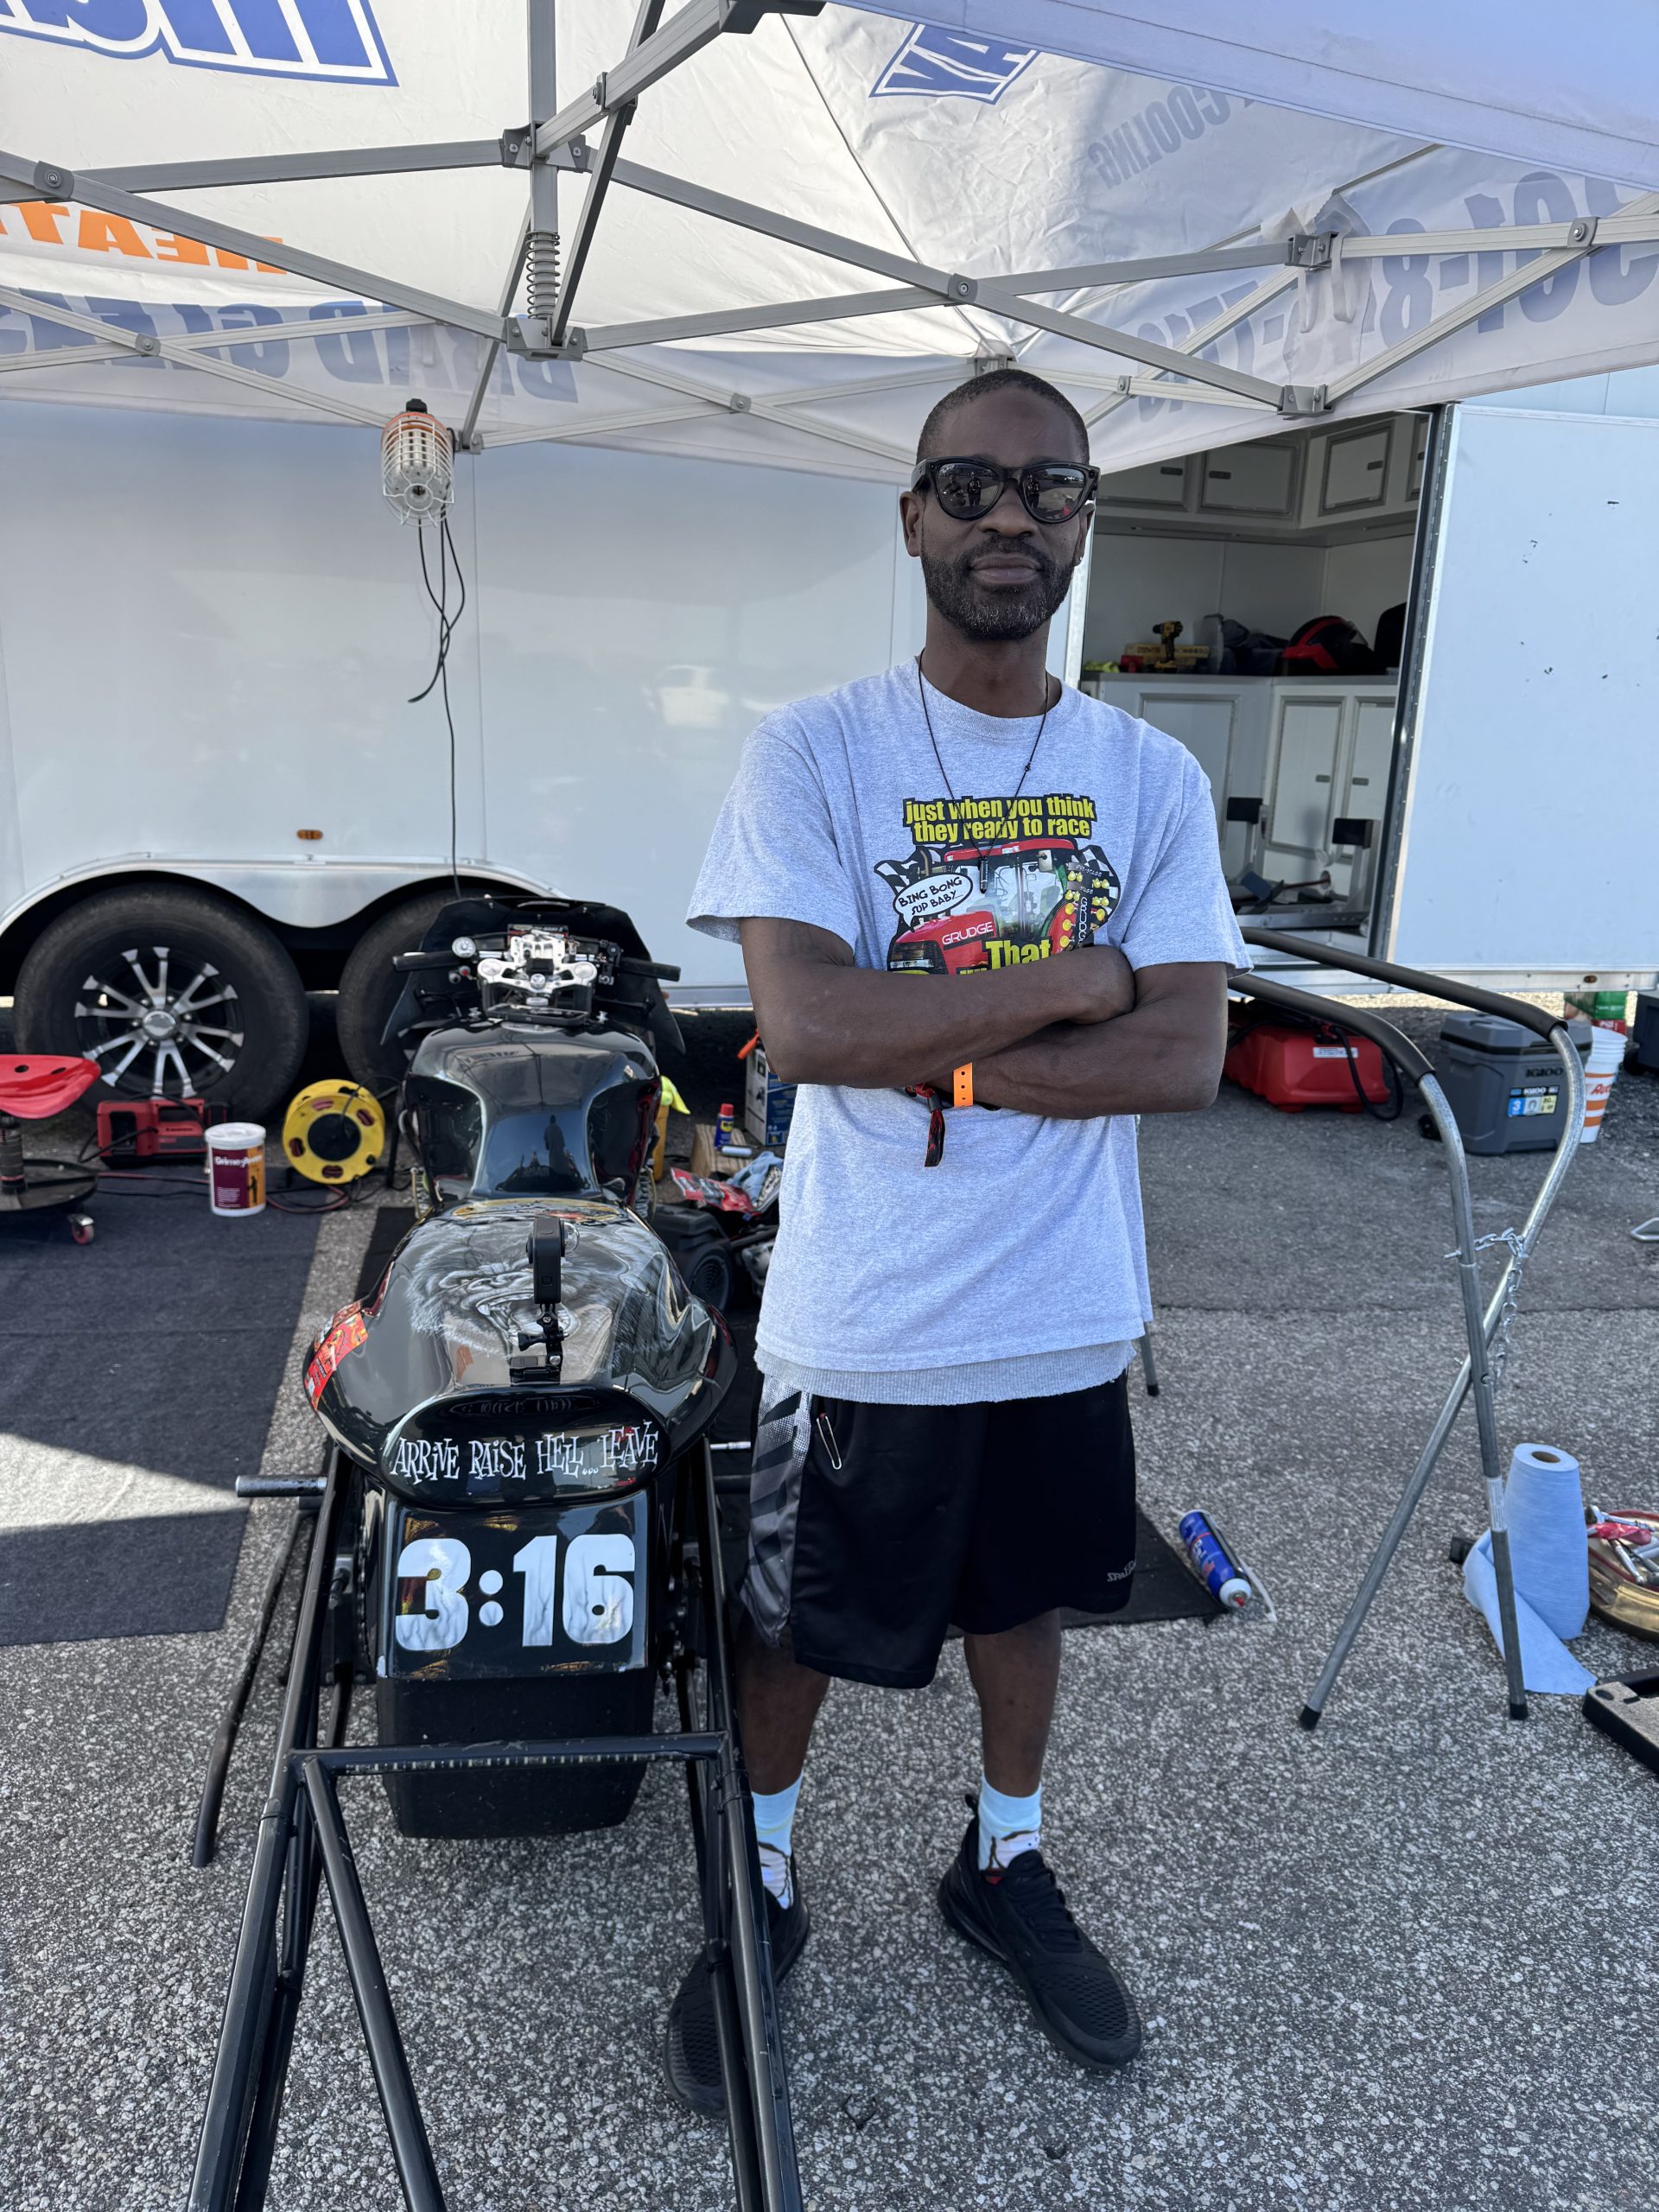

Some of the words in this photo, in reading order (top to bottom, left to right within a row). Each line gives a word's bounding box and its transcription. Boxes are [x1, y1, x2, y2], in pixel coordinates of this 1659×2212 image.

[906, 798, 944, 824] just
[948, 798, 1002, 820] when
[1007, 796, 1043, 820] you
[1046, 794, 1095, 819] think
[913, 821, 958, 843] they
[963, 817, 1018, 840] ready
[1023, 817, 1043, 836] to
[1047, 817, 1090, 837] race
[898, 890, 928, 907] BING
[912, 902, 929, 916] SUP
[942, 921, 994, 945] GRUDGE
[985, 938, 1052, 970] That
[395, 1533, 636, 1652] 3:16
